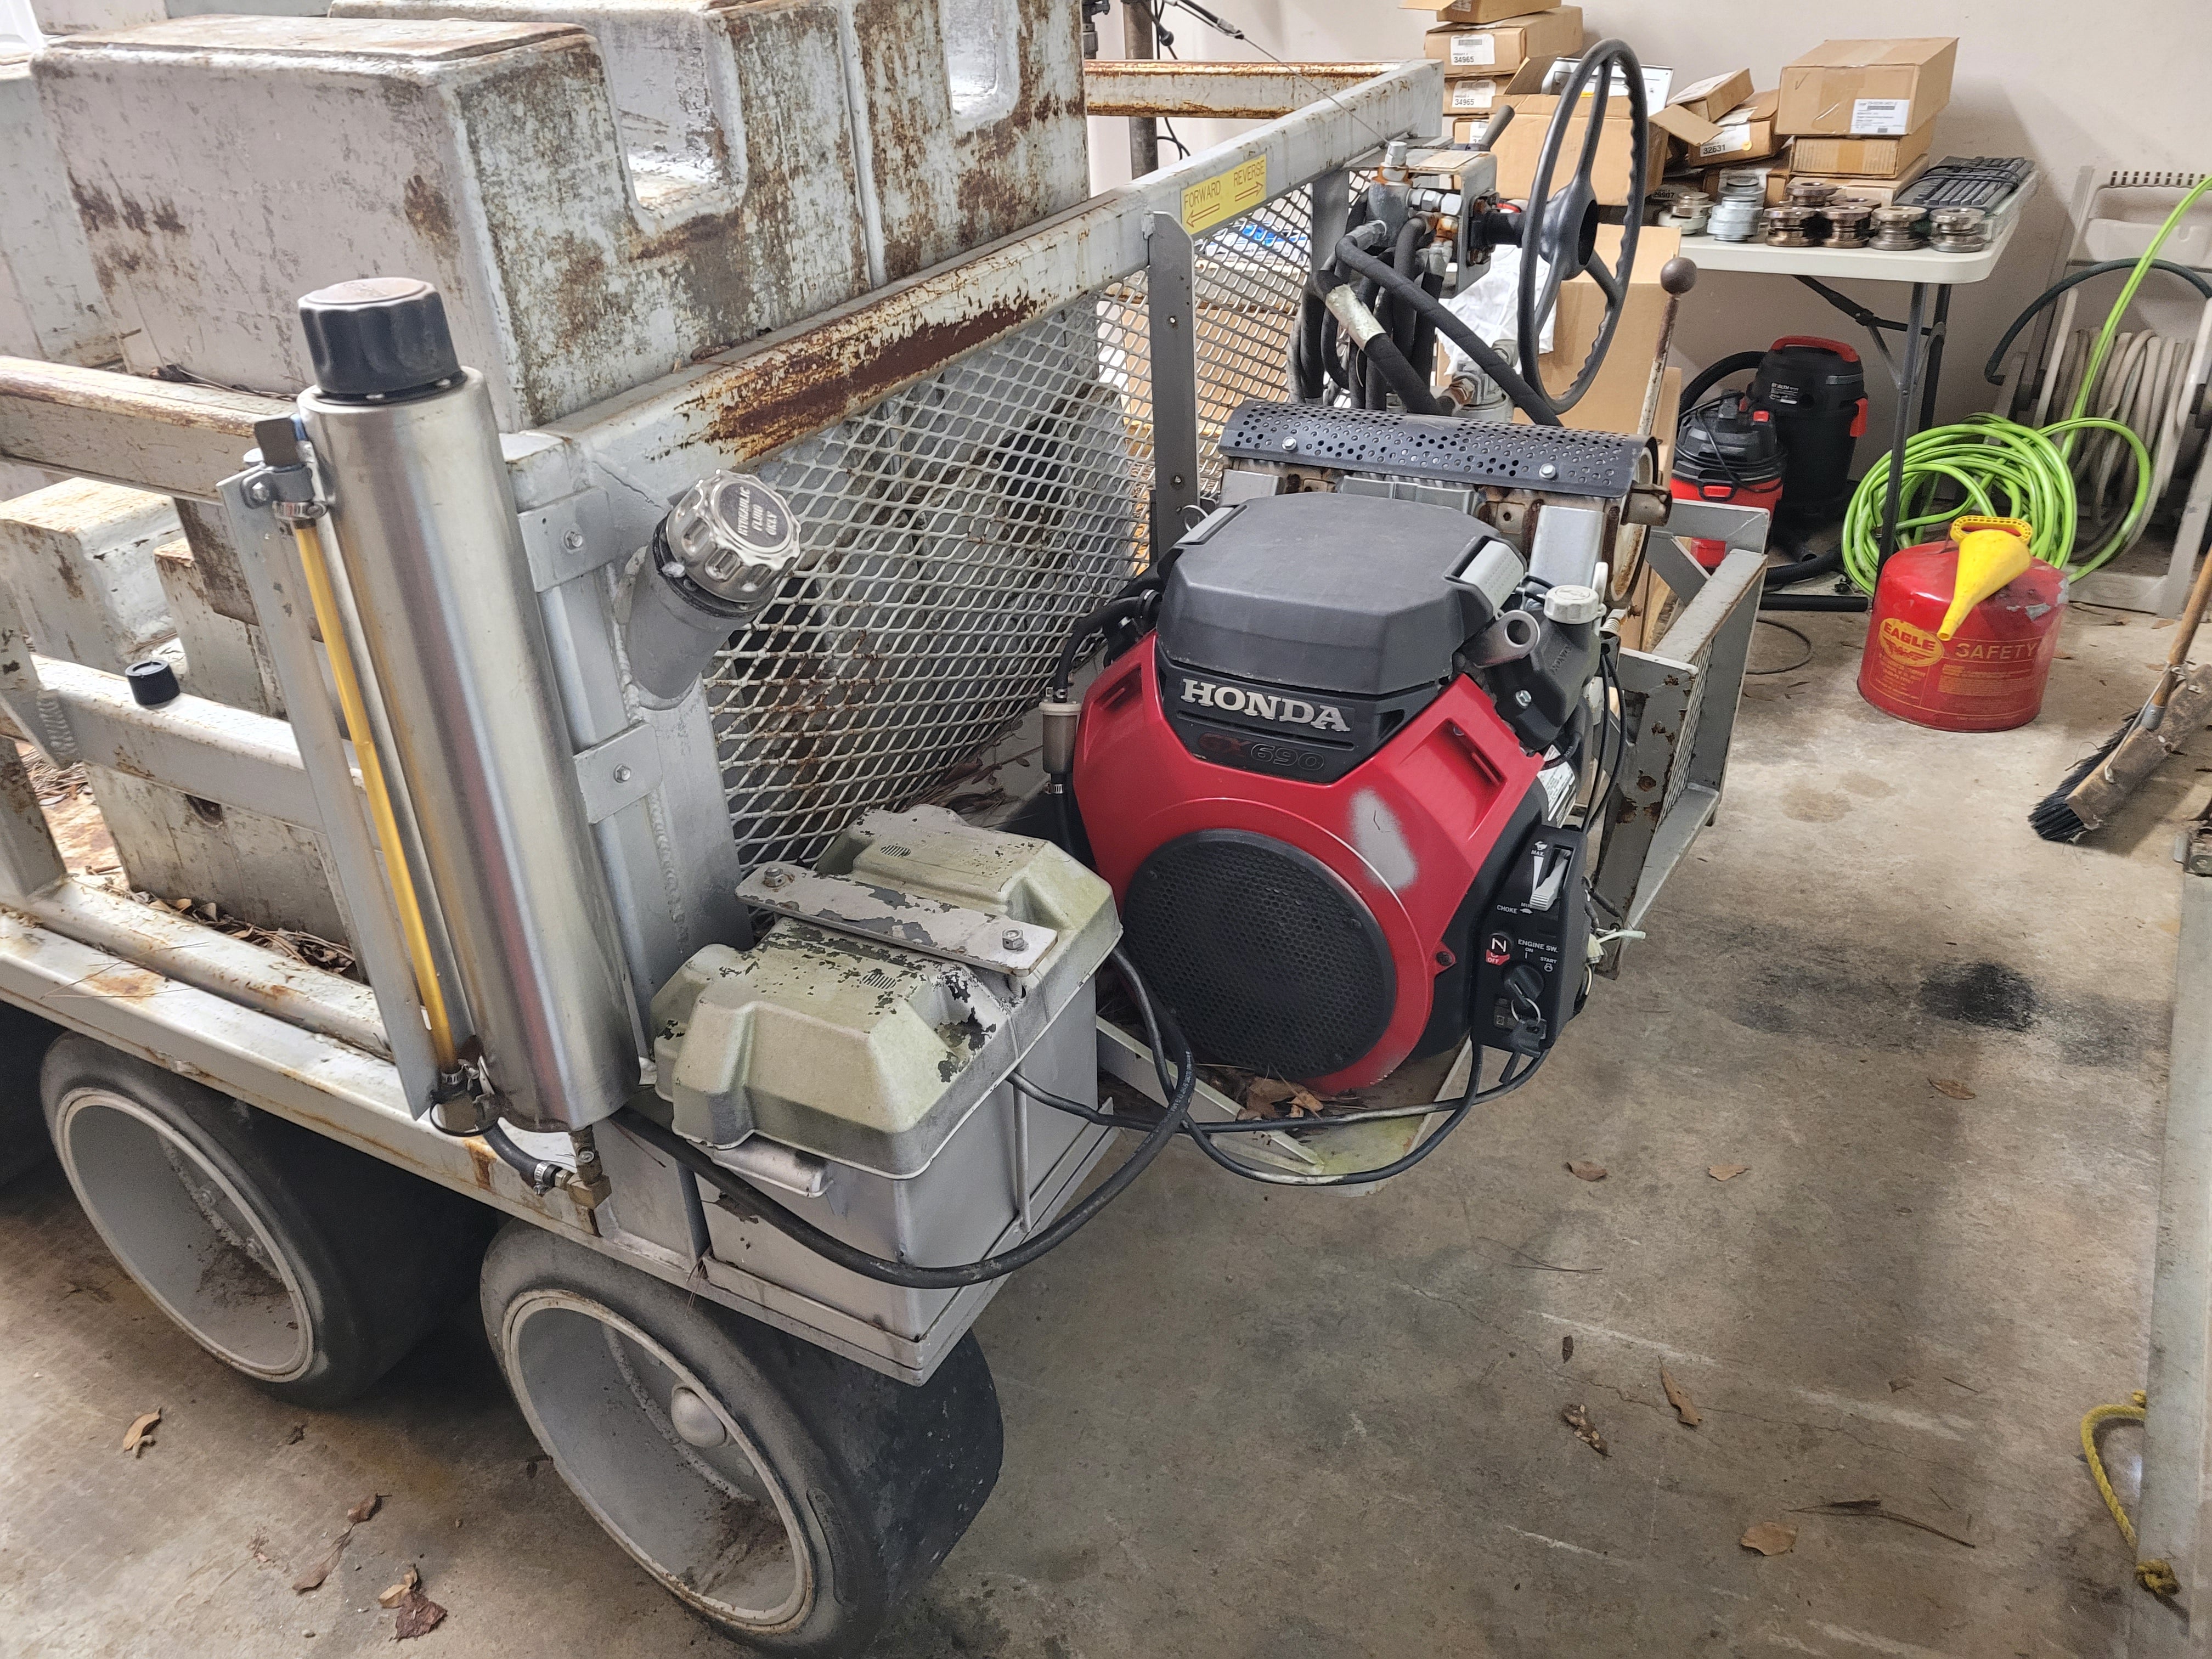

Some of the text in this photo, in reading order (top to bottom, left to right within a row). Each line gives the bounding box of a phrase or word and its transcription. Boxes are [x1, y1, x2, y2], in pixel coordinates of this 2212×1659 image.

[1703, 144, 1725, 154] 32631
[1184, 160, 1265, 210] FORWARD REVERSE
[738, 486, 750, 536] HYDRAULIC
[752, 504, 763, 531] FLUID
[1884, 622, 1936, 651] EAGLE
[1955, 642, 2038, 659] SAFETY
[1180, 678, 1351, 732] HONDA
[1251, 743, 1324, 771] 690
[1497, 905, 1518, 915] CHOKE
[1517, 939, 1545, 950] ENGINE
